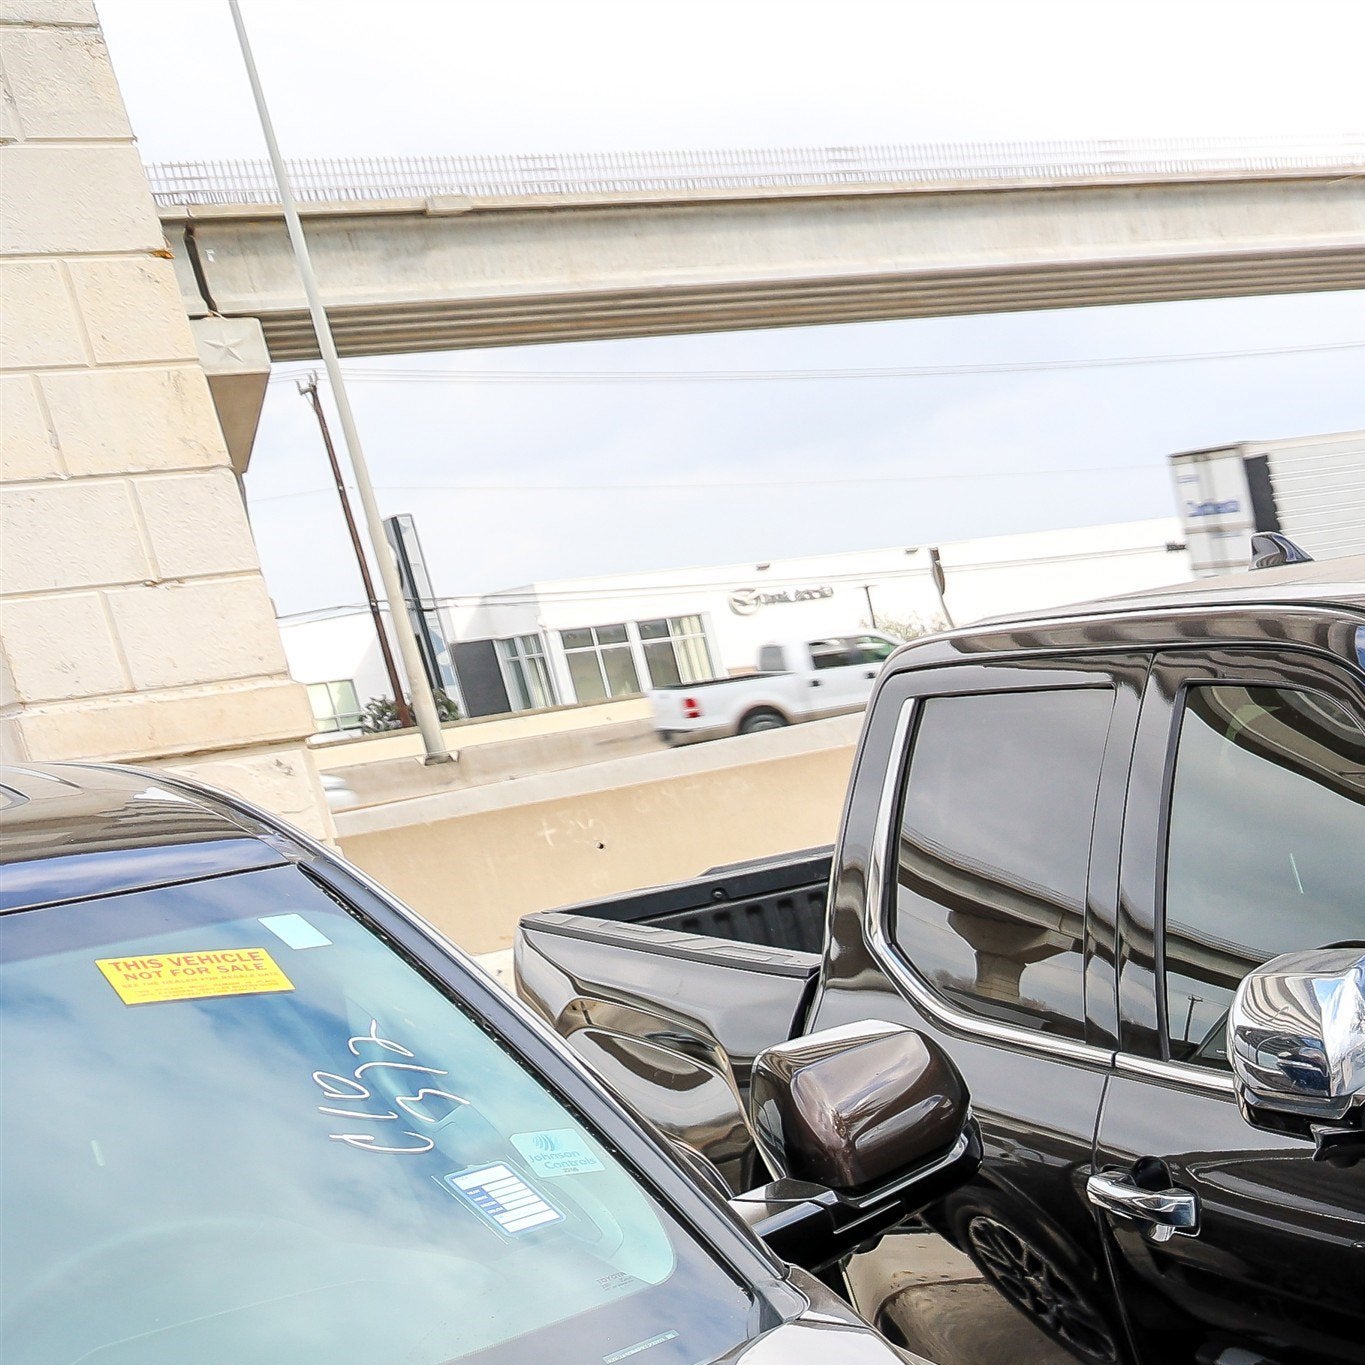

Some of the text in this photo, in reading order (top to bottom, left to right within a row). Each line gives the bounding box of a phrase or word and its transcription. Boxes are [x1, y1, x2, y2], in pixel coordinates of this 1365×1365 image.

[108, 951, 265, 973] THIS VEHICLE
[123, 962, 267, 982] NOT FOR SALE
[529, 1150, 581, 1163] Johnson
[544, 1157, 597, 1170] Controls
